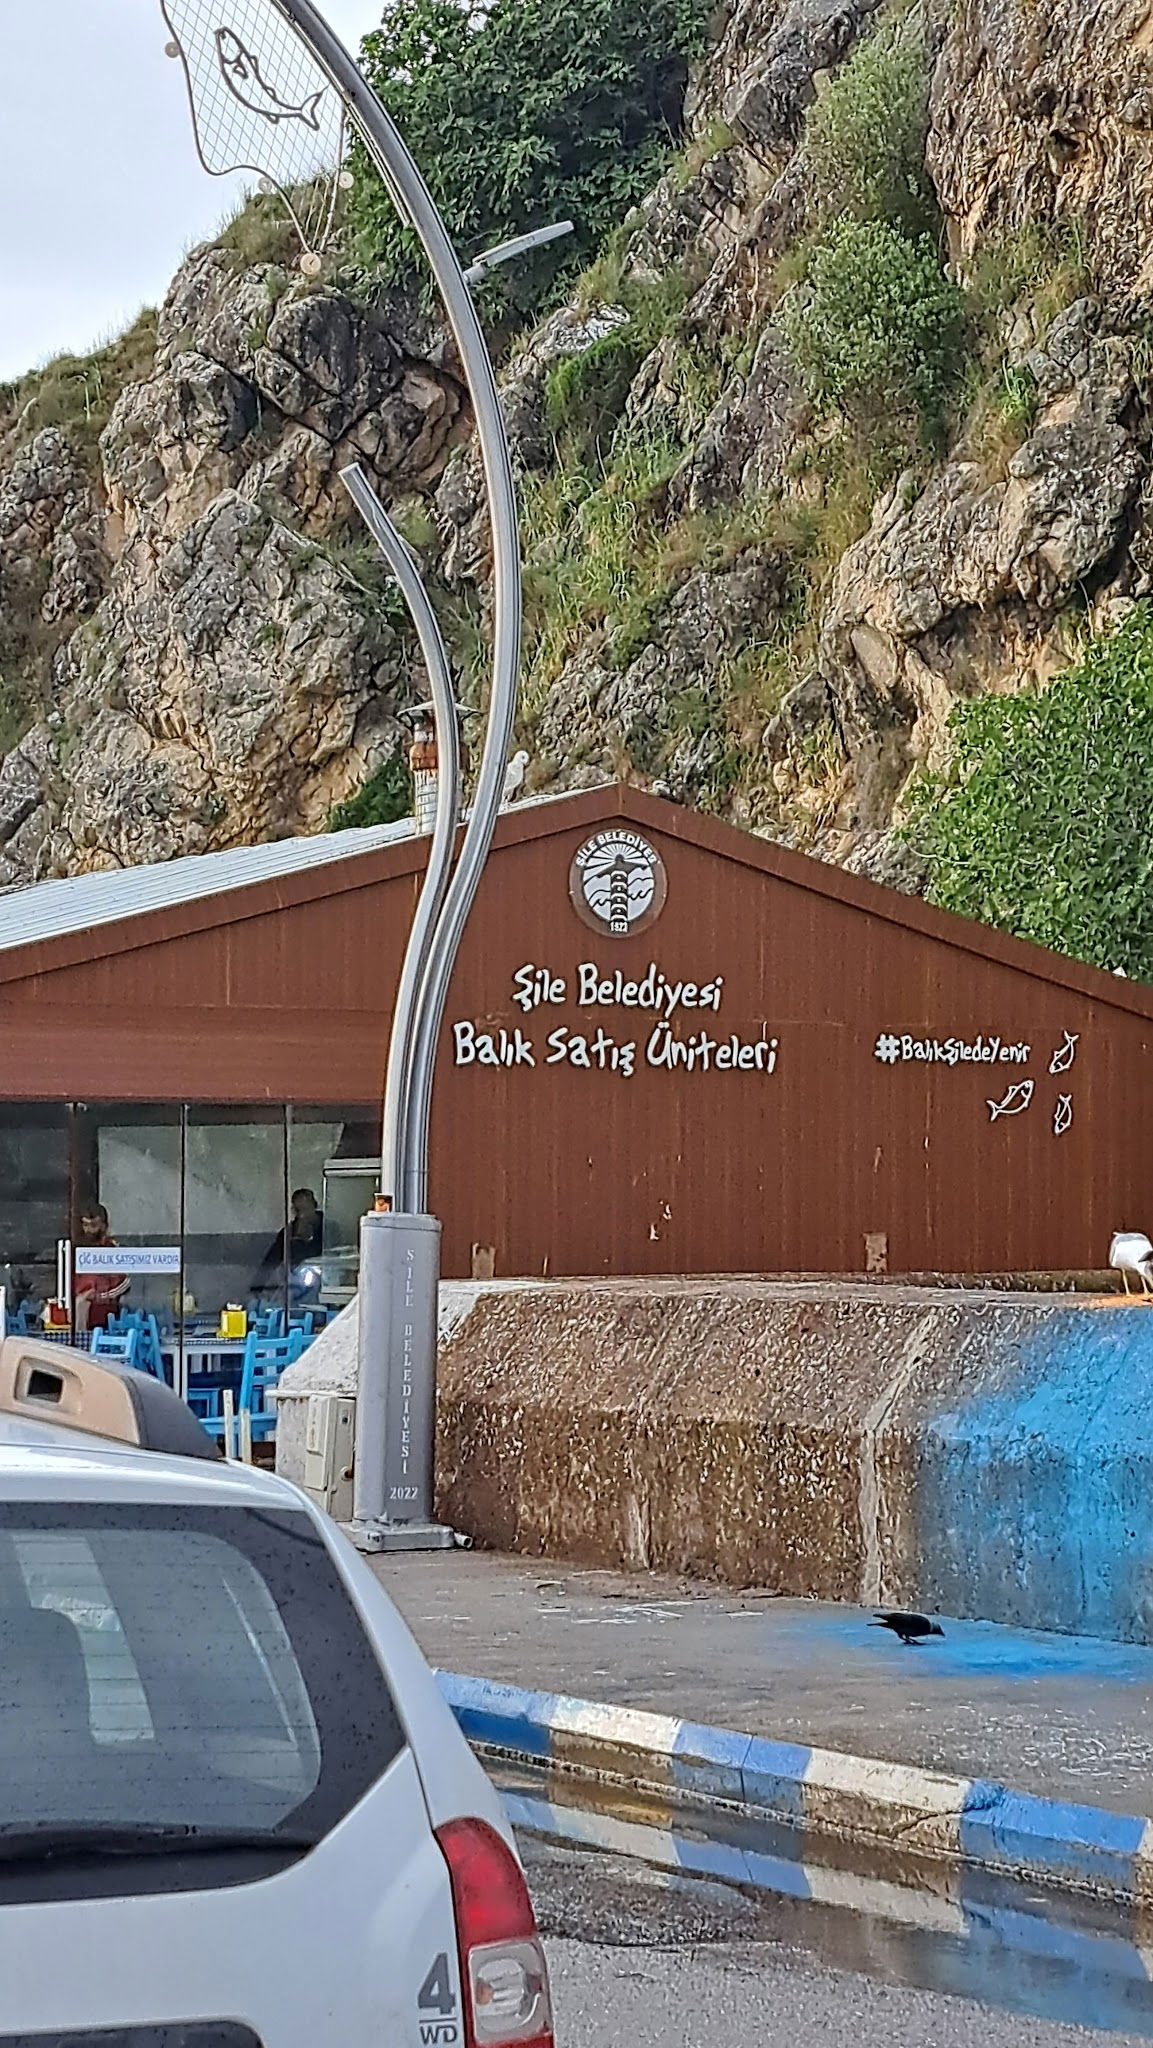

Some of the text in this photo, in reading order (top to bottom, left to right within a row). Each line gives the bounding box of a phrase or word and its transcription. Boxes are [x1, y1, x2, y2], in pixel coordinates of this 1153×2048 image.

[512, 961, 725, 1019] Şile Belediyesi
[453, 1020, 778, 1078] Balık Satış Üniteleri
[389, 1486, 419, 1499] 2022
[417, 1952, 456, 2015] 4
[420, 2025, 458, 2045] WD
